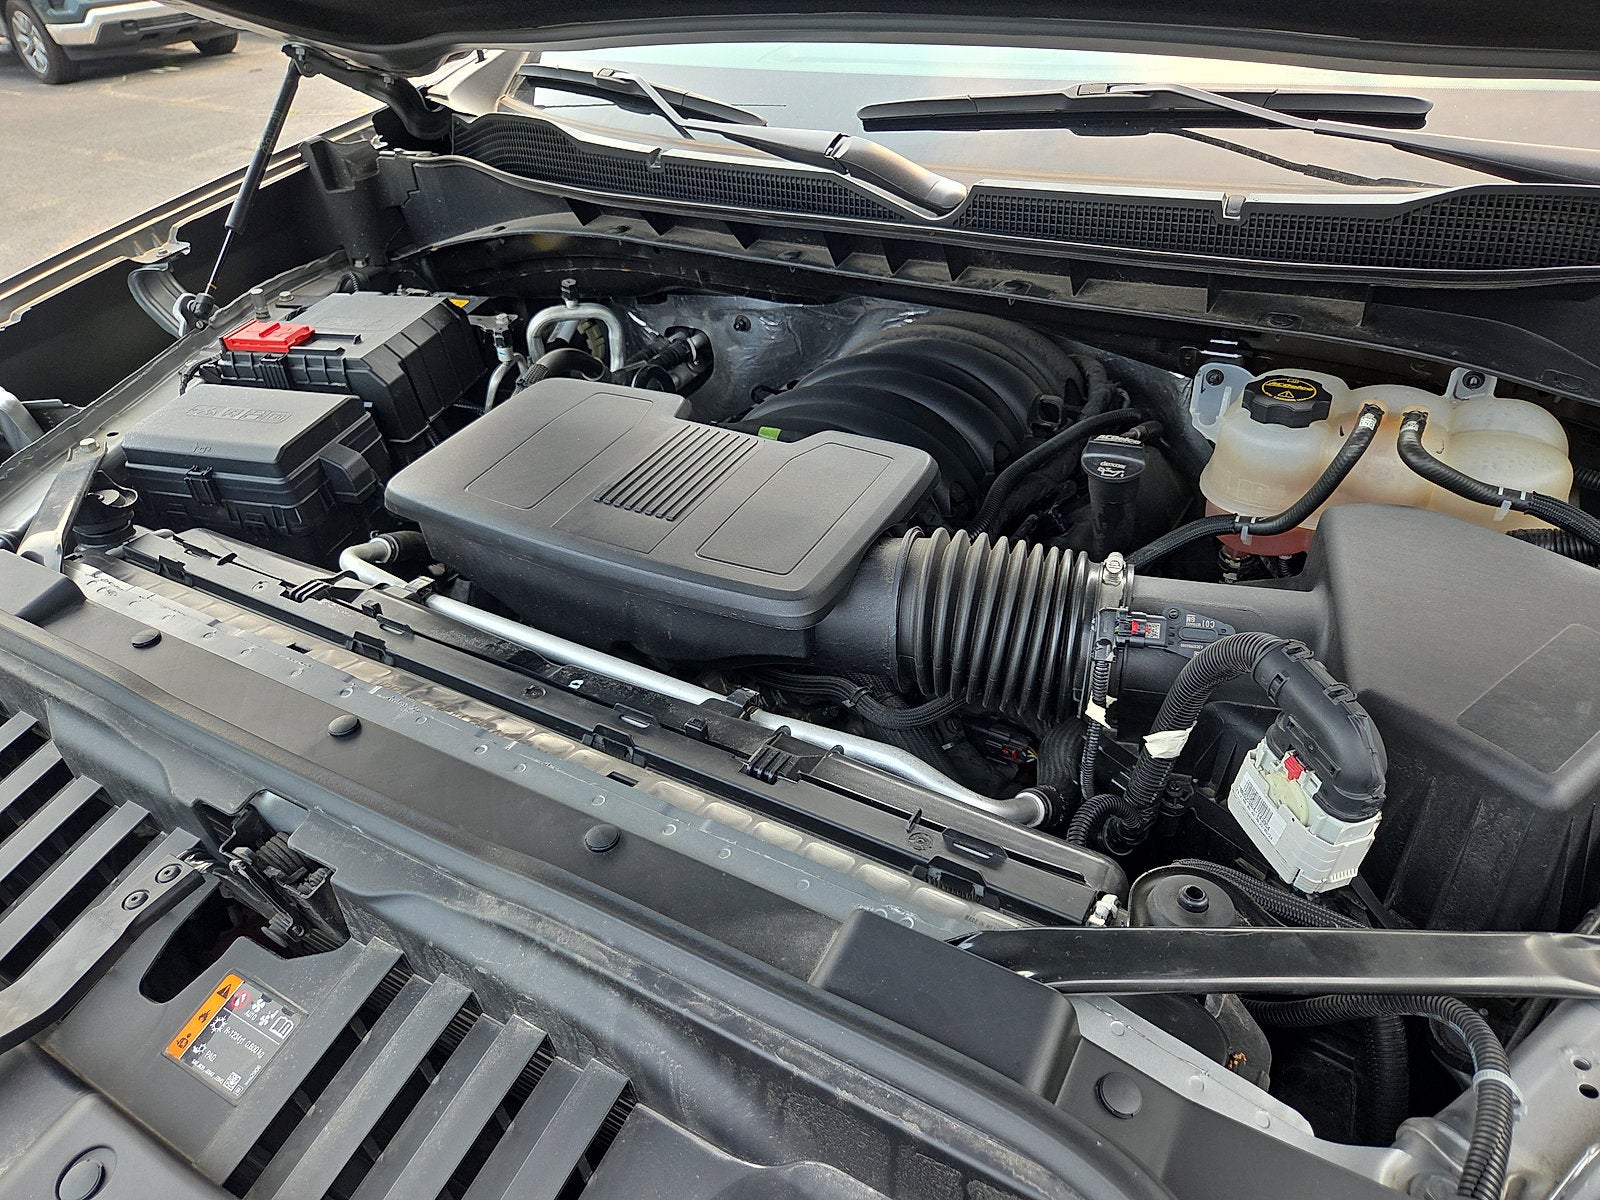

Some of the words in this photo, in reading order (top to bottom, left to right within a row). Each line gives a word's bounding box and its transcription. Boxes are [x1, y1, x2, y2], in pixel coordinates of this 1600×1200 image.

[1093, 434, 1141, 445] ACDelco
[244, 1010, 258, 1020] AUTO
[257, 1049, 265, 1059] kg
